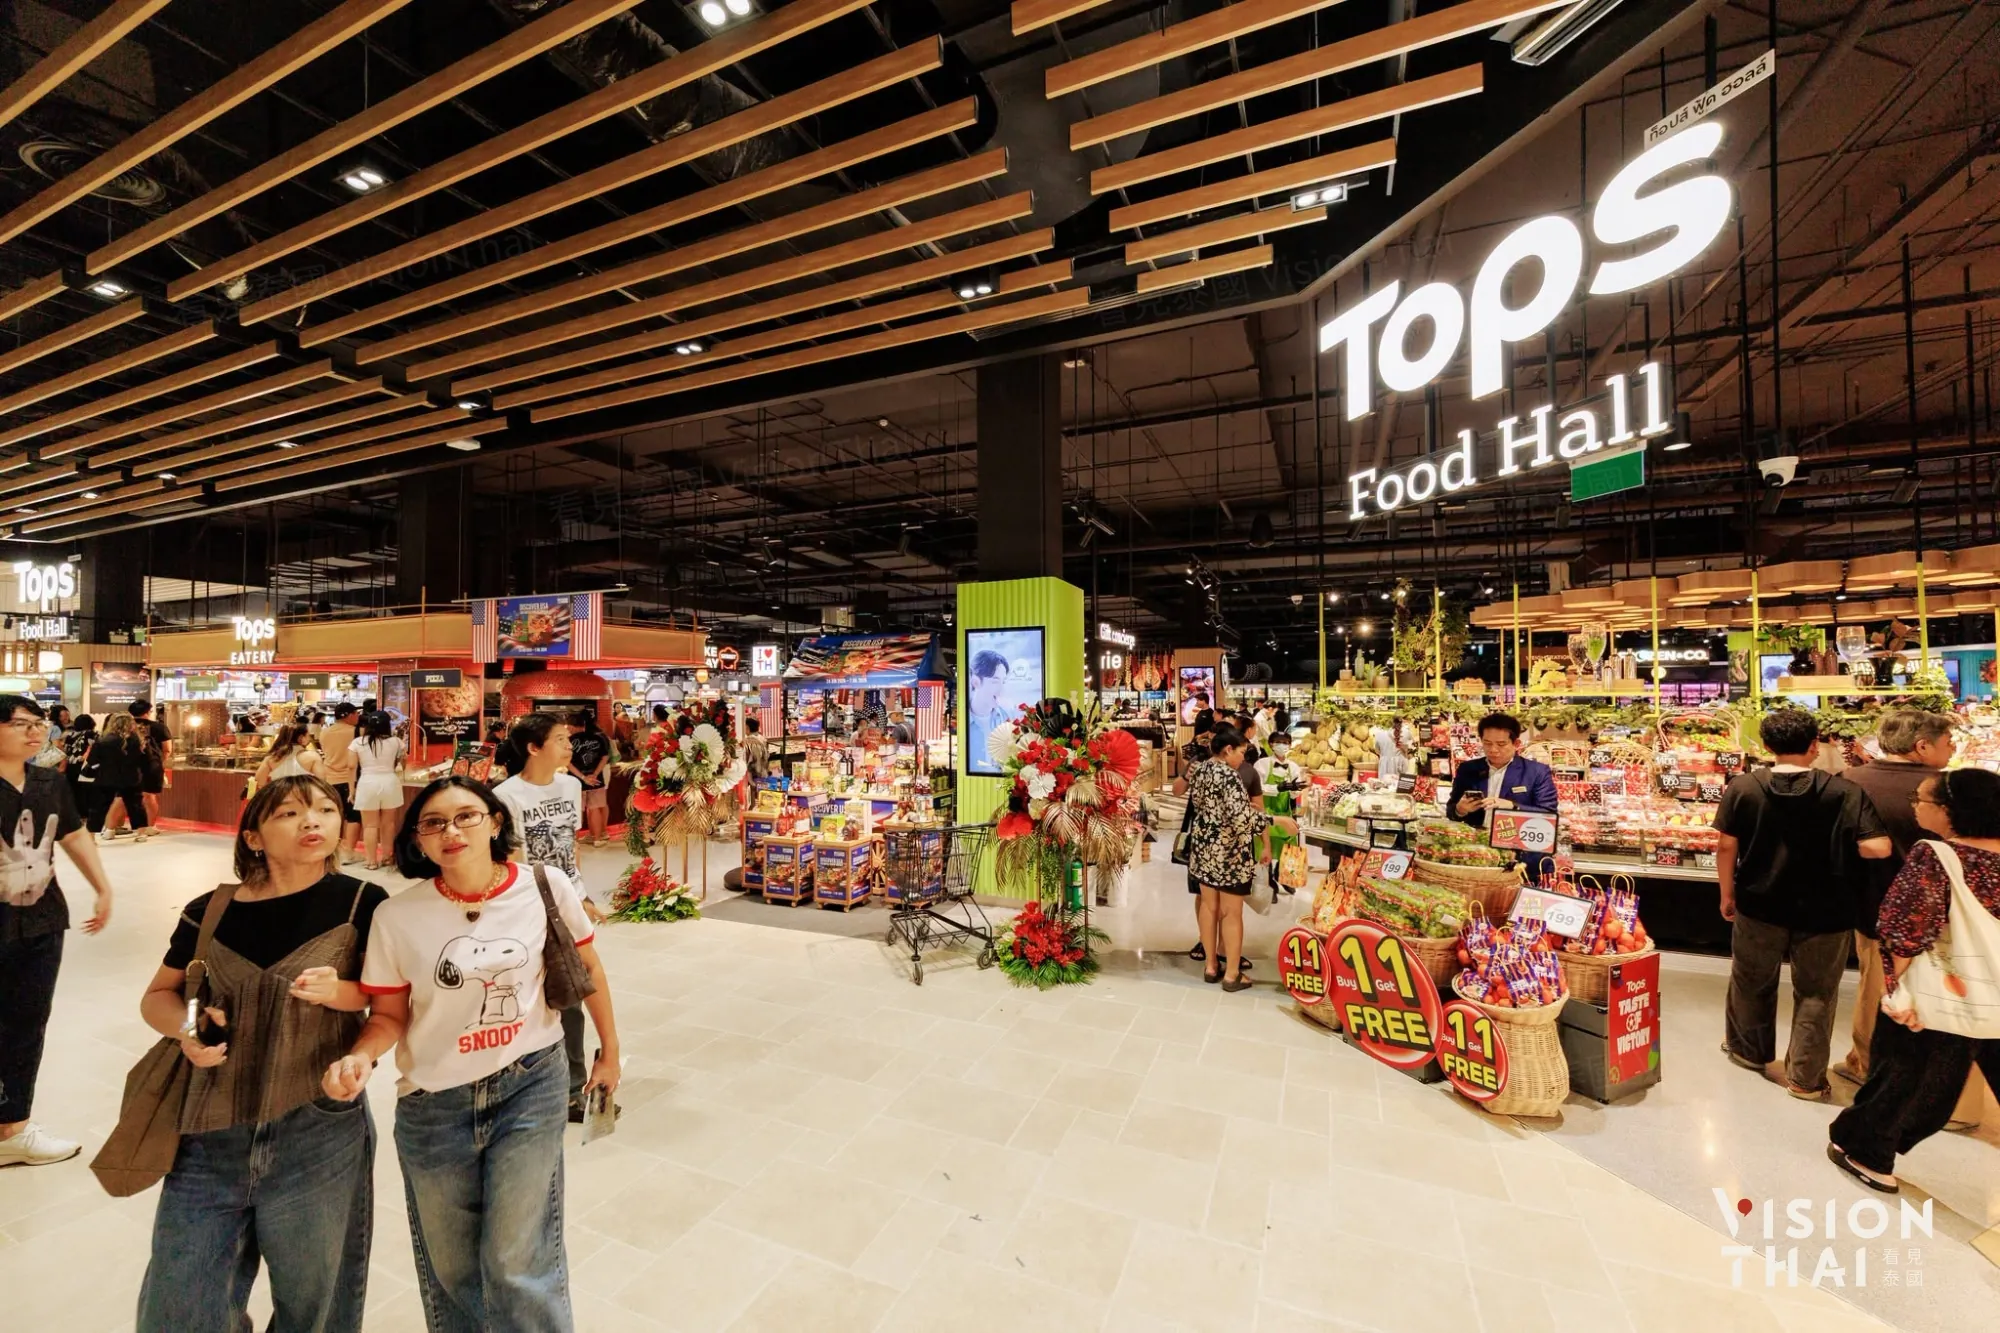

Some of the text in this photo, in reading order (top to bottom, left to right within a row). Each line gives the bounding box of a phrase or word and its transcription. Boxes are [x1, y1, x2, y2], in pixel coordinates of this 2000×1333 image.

[1320, 122, 1732, 422] Tops
[1349, 430, 1476, 520] Food
[1498, 362, 1669, 477] Hall
[14, 561, 74, 612] Tops
[20, 617, 68, 640] Food Hall
[232, 617, 276, 646] Tops
[230, 650, 276, 665] EATERY
[425, 675, 445, 683] PIZZA
[523, 799, 576, 822] MAVERICK
[1498, 830, 1517, 839] FREE
[1520, 830, 1544, 843] 299
[1384, 863, 1401, 873] 199
[1547, 911, 1575, 926] 199
[1289, 937, 1301, 967] 1
[1307, 938, 1319, 970] 1
[1336, 936, 1414, 998] Buy 1 Get 1
[1286, 972, 1323, 994] FREE
[1626, 979, 1646, 993] Tops
[1618, 992, 1650, 1016] TASTE
[1345, 1004, 1431, 1046] FREE
[1448, 1010, 1466, 1050] 1
[1626, 1010, 1642, 1032] OF
[1468, 1041, 1482, 1052] Get
[1474, 1018, 1493, 1059] 1
[1617, 1026, 1650, 1055] VICTORY
[1444, 1053, 1497, 1091] FREE
